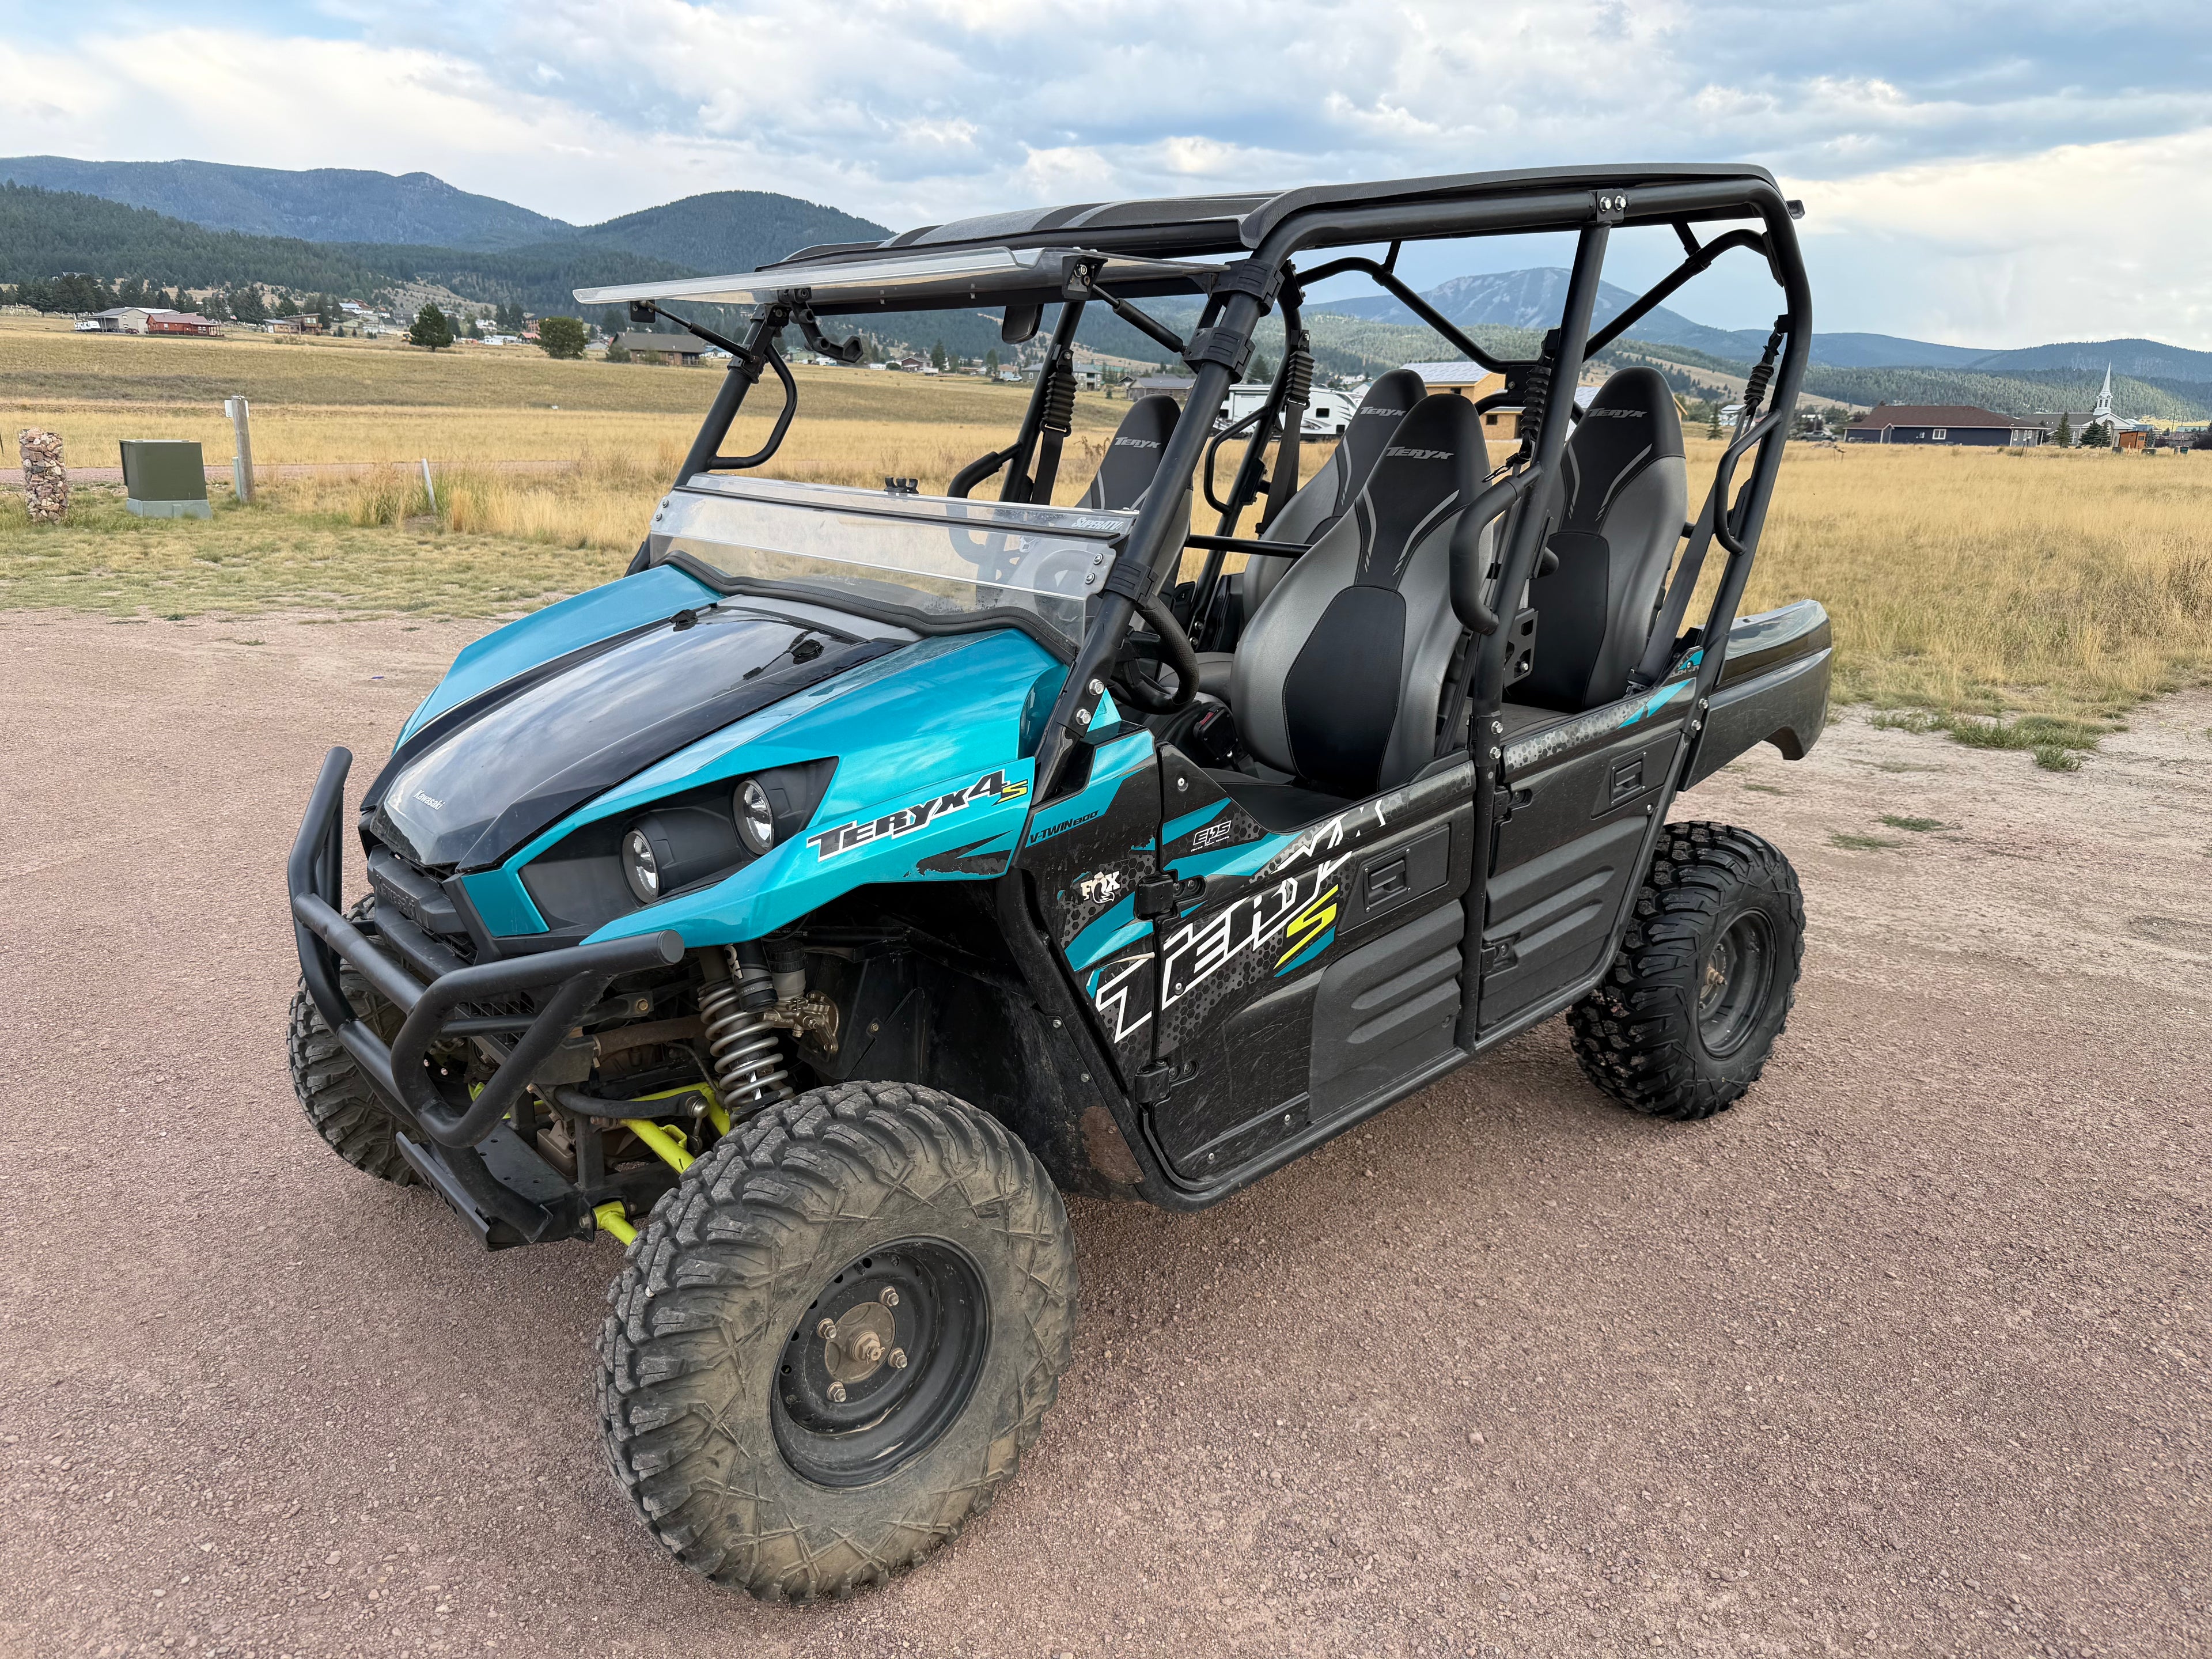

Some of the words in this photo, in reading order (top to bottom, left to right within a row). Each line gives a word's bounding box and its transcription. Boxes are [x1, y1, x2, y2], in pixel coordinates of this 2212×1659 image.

[1361, 407, 1407, 416] TERYX
[1589, 408, 1647, 418] TERYX
[1115, 437, 1161, 448] TERYX
[1386, 446, 1455, 460] TERYX
[413, 789, 446, 810] Kawasaki
[1192, 820, 1232, 846] EPS
[1080, 870, 1120, 903] FOX
